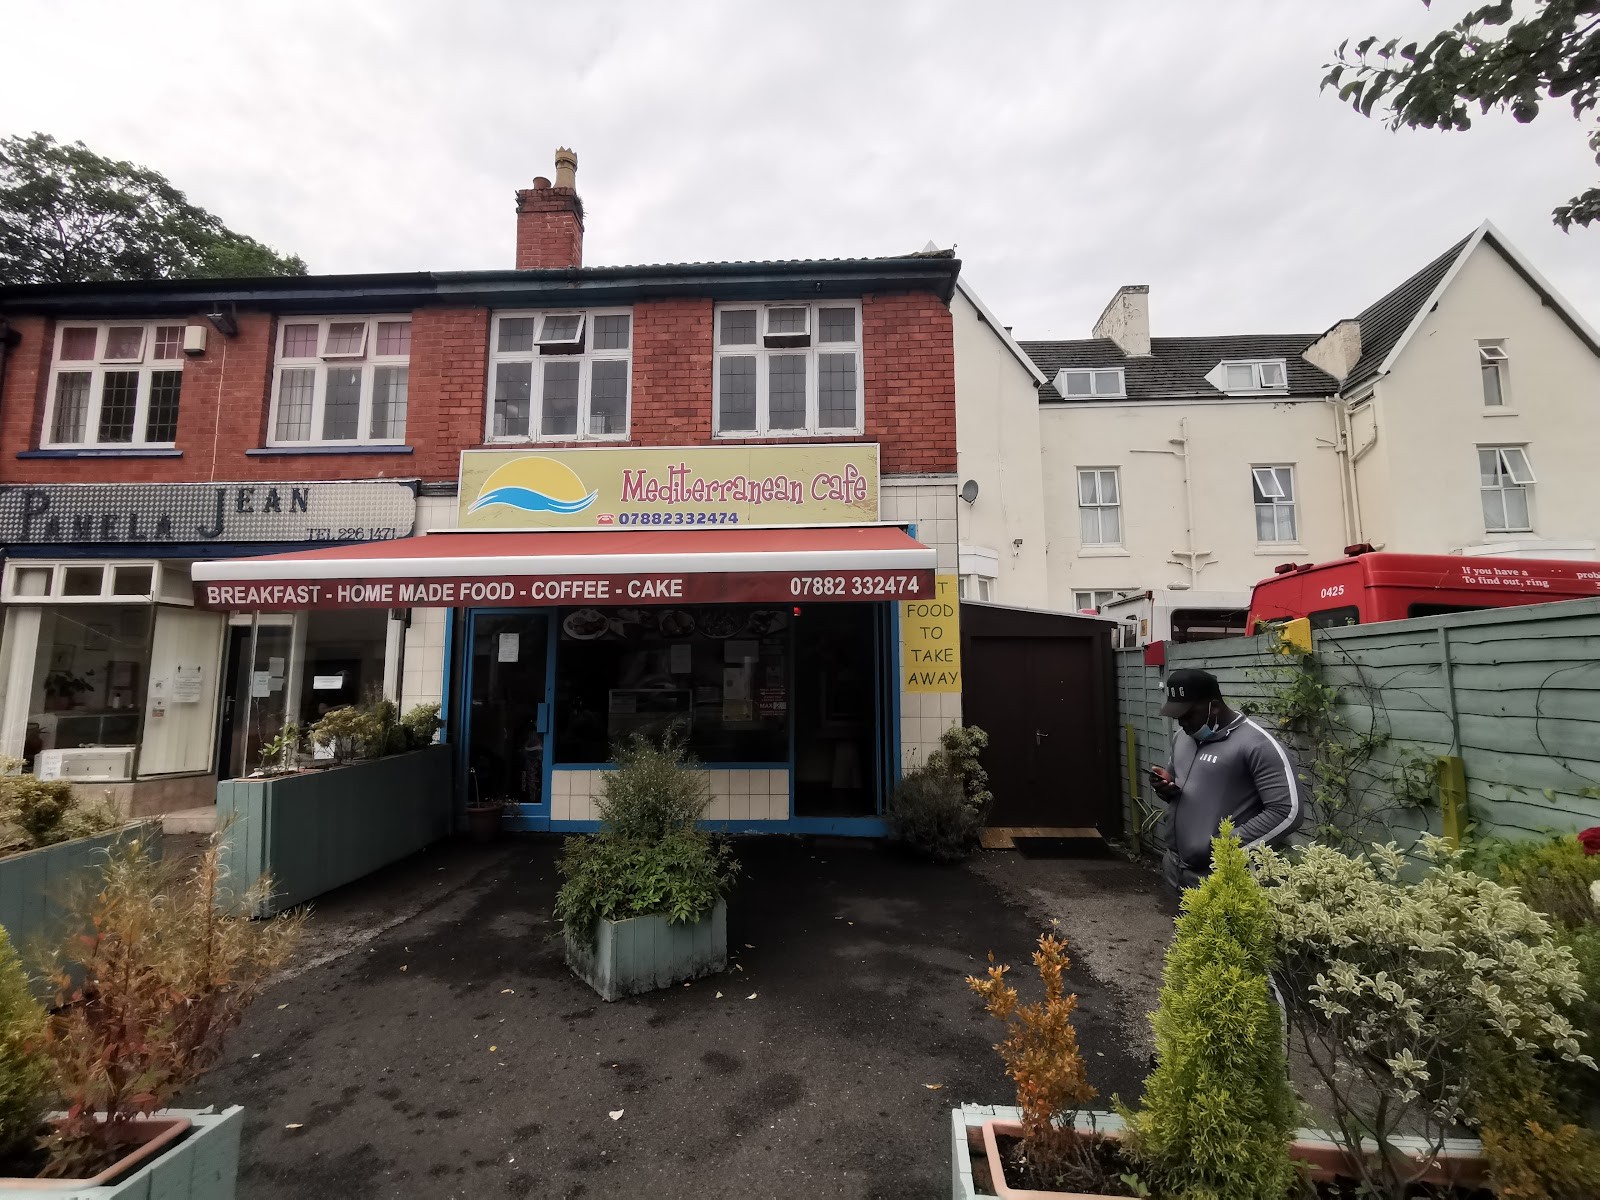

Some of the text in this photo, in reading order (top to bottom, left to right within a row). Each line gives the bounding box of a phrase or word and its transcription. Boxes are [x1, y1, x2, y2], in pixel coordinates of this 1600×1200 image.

[620, 462, 804, 505] Mediterranean
[618, 512, 739, 525] 07882332474
[338, 527, 364, 541] 226
[367, 527, 396, 540] 1471
[1461, 566, 1471, 574] If
[1473, 568, 1492, 576] you
[1494, 568, 1519, 576] have
[1576, 571, 1600, 580] prob
[790, 575, 919, 595] 07882 332474
[1462, 575, 1549, 588] To find out, ring
[207, 585, 321, 604] BREAKFAST
[337, 584, 393, 602] HOME
[399, 583, 455, 602] MADE
[460, 582, 515, 601] FOOD
[531, 580, 610, 600] COFFEE
[627, 579, 683, 598] CAKE
[1320, 585, 1345, 599] 0425
[906, 604, 954, 618] FOOD
[920, 626, 943, 640] TO
[911, 648, 953, 662] TAKE
[908, 671, 958, 685] AWAY
